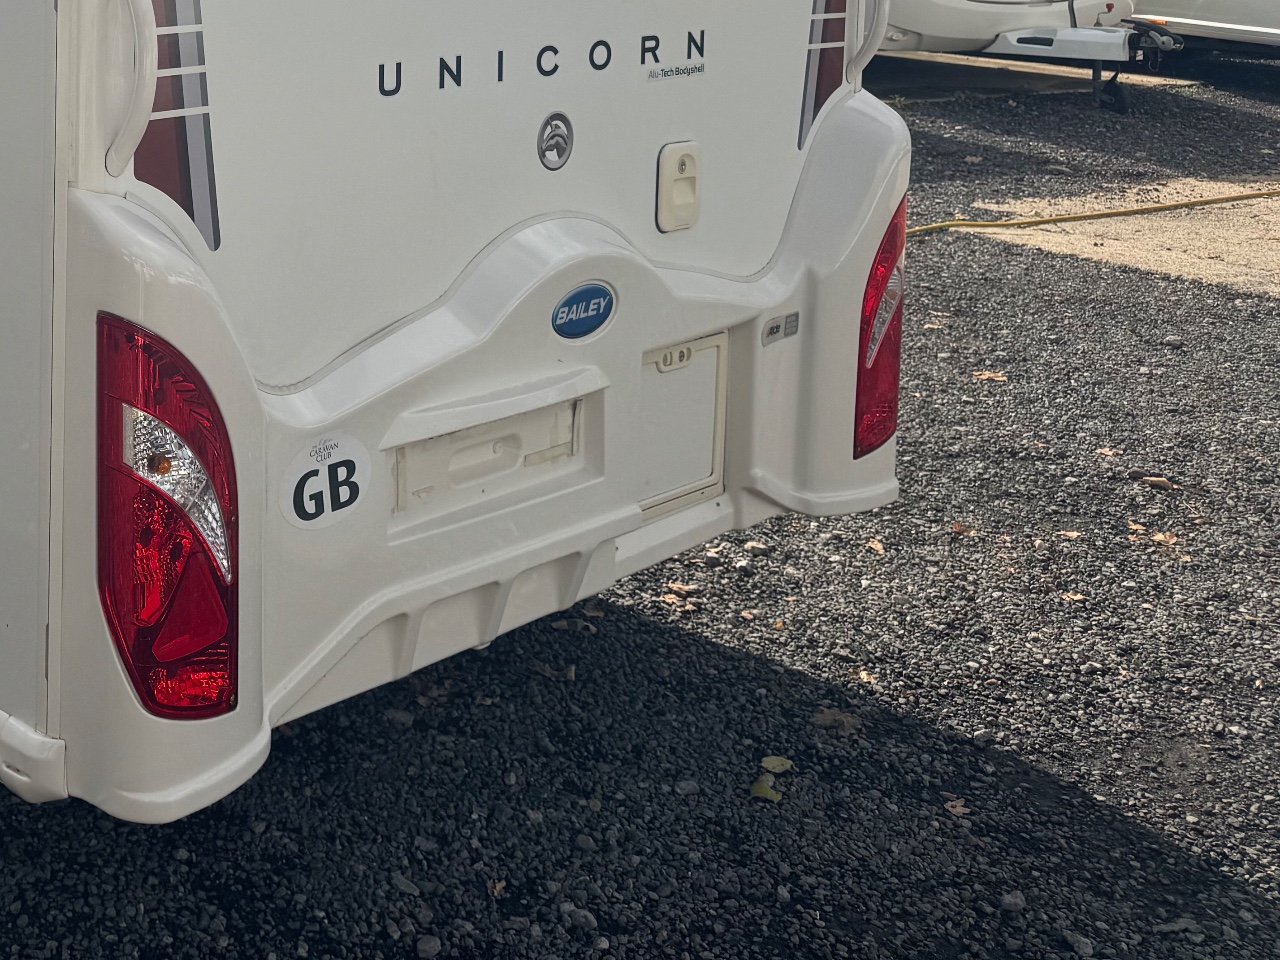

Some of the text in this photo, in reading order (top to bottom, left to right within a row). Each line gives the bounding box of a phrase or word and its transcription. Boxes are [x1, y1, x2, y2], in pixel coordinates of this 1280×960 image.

[378, 29, 706, 97] UNICORN
[648, 63, 705, 79] Alu-Tech Bodyshell
[555, 295, 610, 325] BAILEY
[310, 442, 339, 457] CARAVAN
[316, 451, 332, 462] CLUB
[292, 458, 360, 522] GB
